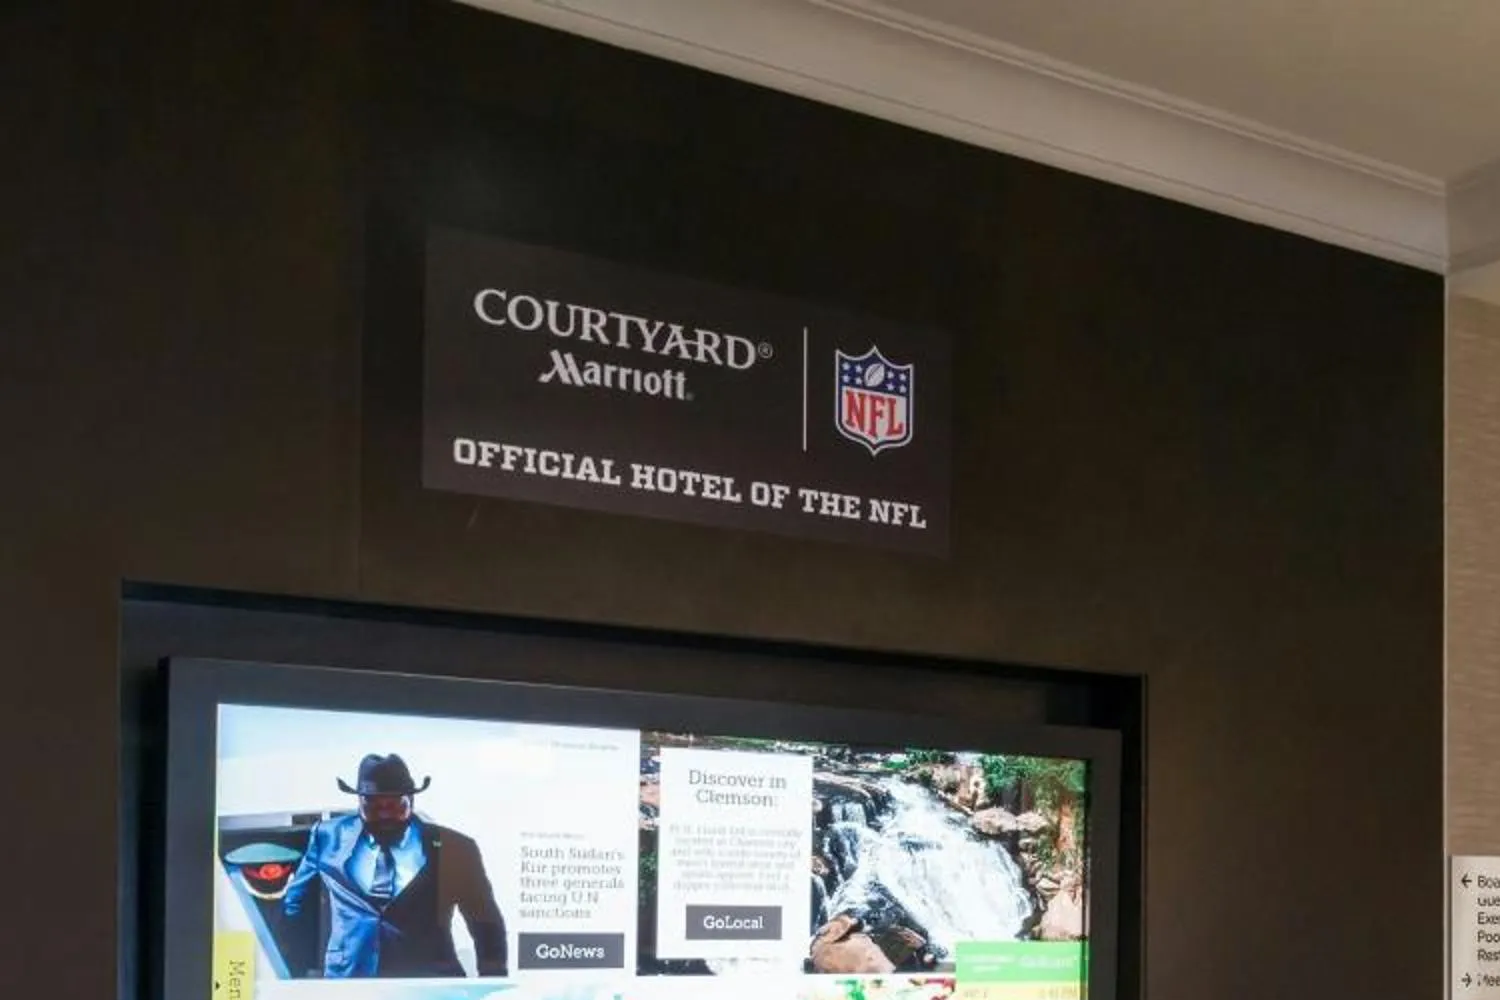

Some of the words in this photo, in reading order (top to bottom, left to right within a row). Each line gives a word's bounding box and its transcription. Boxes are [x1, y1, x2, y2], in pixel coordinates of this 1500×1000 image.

[538, 350, 688, 400] Marriott
[843, 390, 905, 437] NFL
[453, 437, 621, 486] OFFICIAL
[630, 463, 742, 503] HOTEL
[750, 481, 791, 509] OF
[798, 488, 861, 521] THE
[868, 499, 927, 528] NFL
[688, 769, 764, 789] Discover
[769, 775, 788, 789] in
[520, 846, 565, 860] South
[520, 876, 559, 889] three
[561, 877, 625, 892] generals
[703, 914, 764, 930] GoLocal
[535, 943, 605, 960] GoNews
